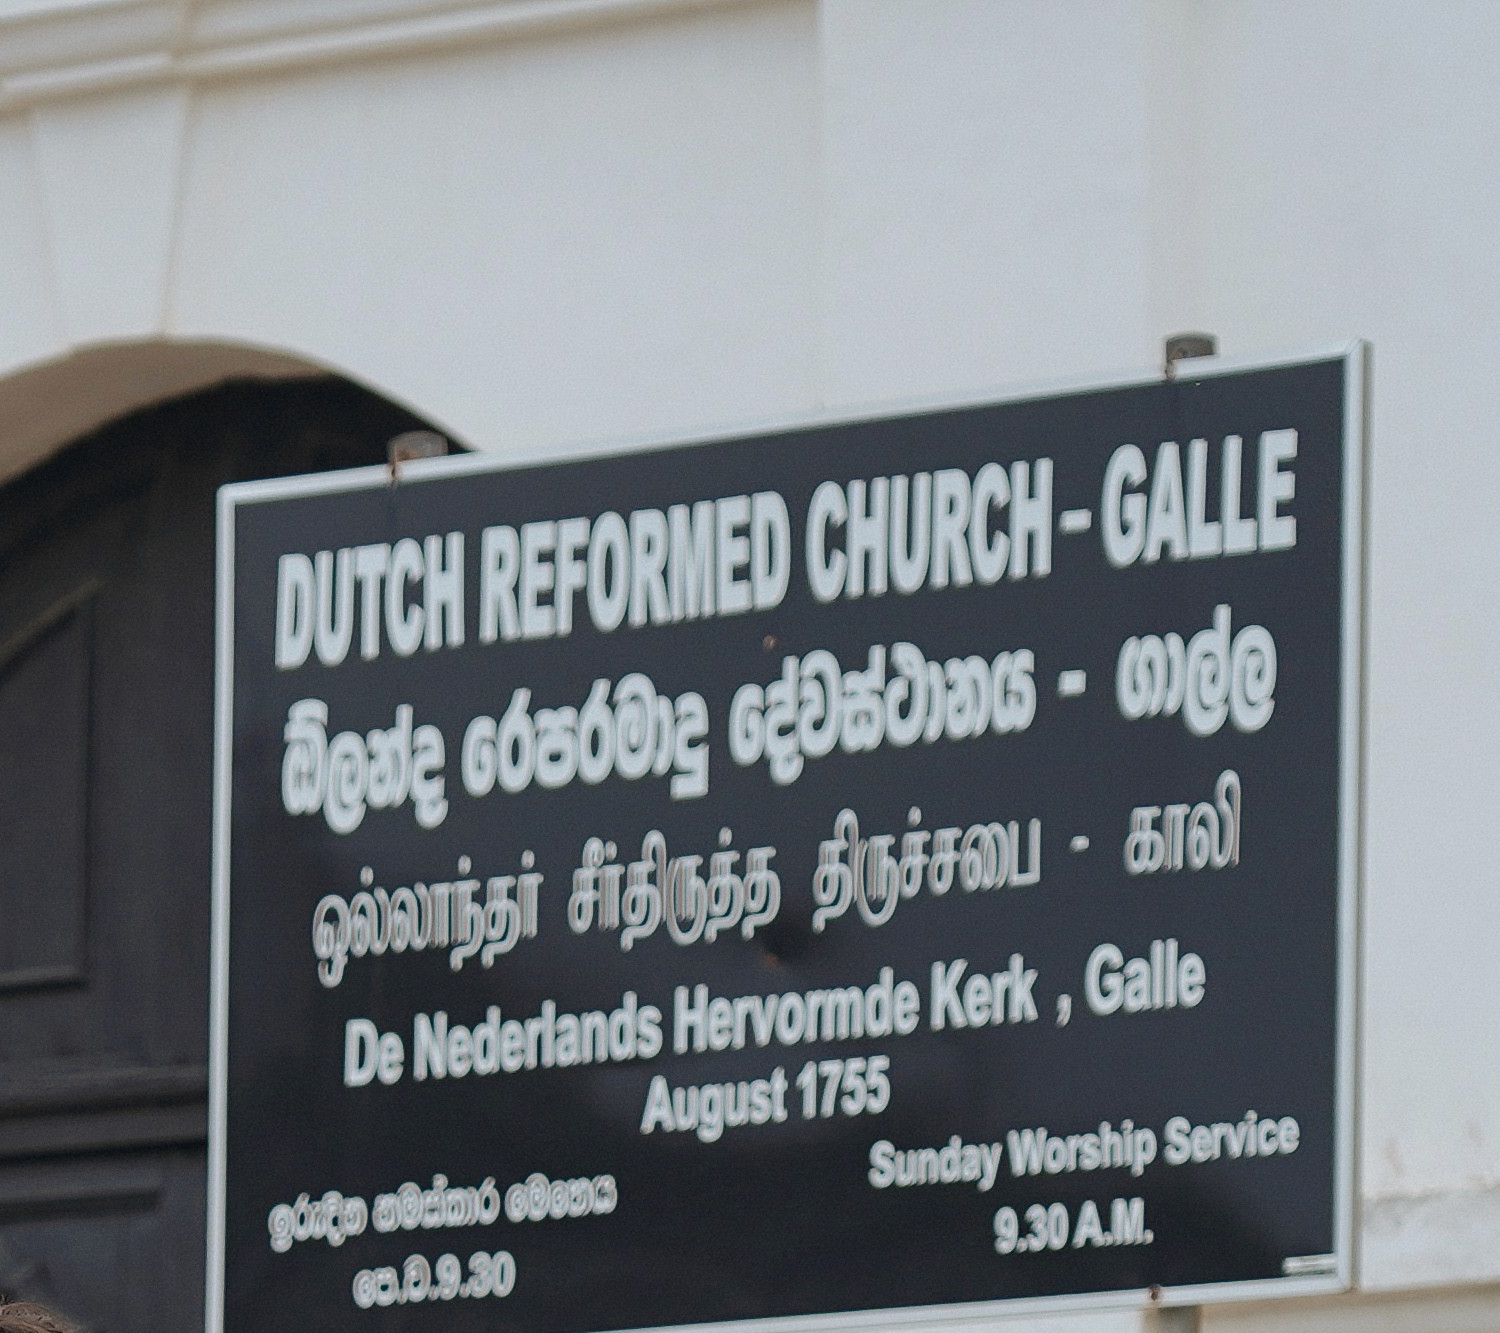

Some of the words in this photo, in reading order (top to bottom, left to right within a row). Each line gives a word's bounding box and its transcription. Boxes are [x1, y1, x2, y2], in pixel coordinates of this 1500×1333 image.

[275, 532, 465, 670] DUTCH
[479, 489, 791, 643] REFORMED
[806, 458, 1053, 602] CHURCH
[1101, 428, 1298, 568] GALLE
[1116, 604, 1277, 736] ගාල්ල
[313, 850, 544, 987] ஒல்லாந்தர்
[568, 827, 780, 951] சீர்திருத்த
[813, 807, 1041, 931] திருச்சபை
[1125, 769, 1241, 874] காலி
[345, 1019, 404, 1086] De
[414, 991, 663, 1081] Nederlands
[674, 967, 920, 1054] Hervormde
[931, 953, 1038, 1030] Kerk
[1085, 938, 1206, 1015] Galle
[640, 1067, 788, 1142] August
[796, 1055, 890, 1119] 1755
[869, 1135, 1002, 1191] Sunday
[1007, 1119, 1157, 1176] Worship
[1164, 1110, 1300, 1165] Service
[995, 1203, 1069, 1254] 9.30
[1073, 1198, 1153, 1248] A.M.
